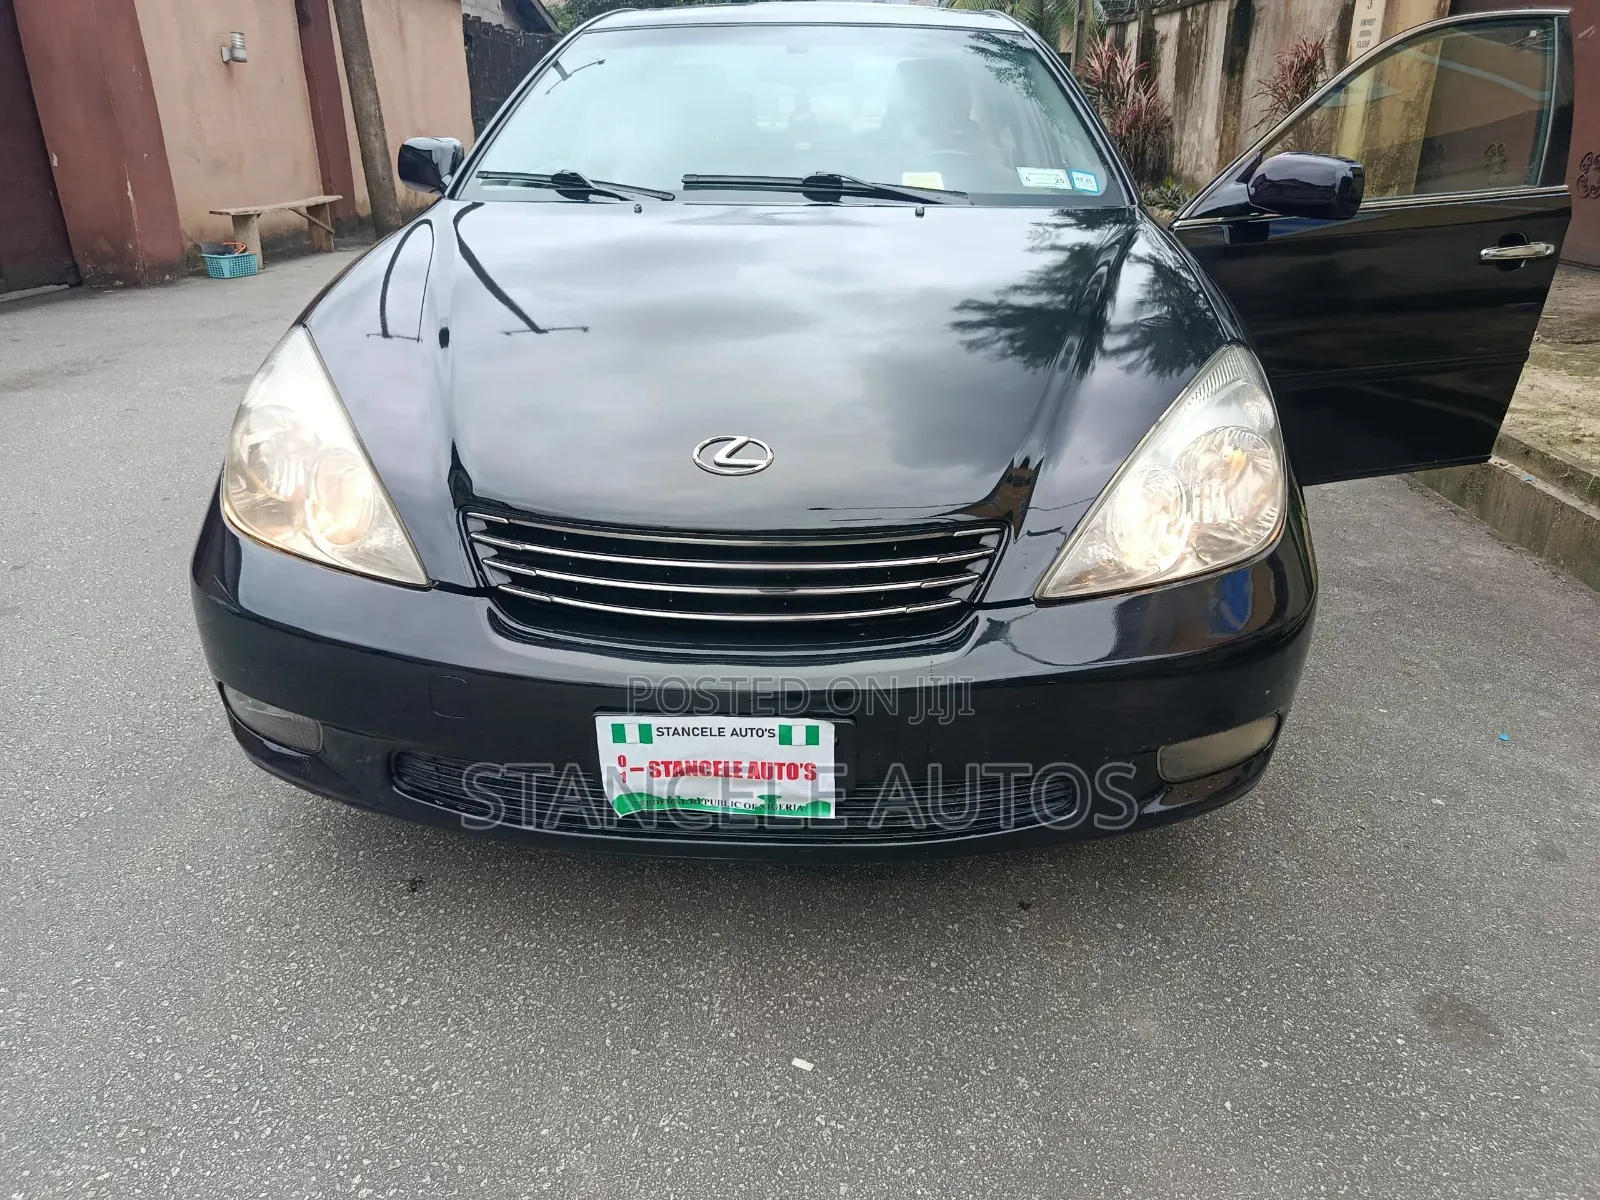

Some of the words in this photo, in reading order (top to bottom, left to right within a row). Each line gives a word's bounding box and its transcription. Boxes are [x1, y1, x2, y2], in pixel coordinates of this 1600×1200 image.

[656, 726, 726, 738] STANCELE
[730, 727, 776, 738] AUTO'S
[648, 759, 743, 778] STANCELE
[747, 761, 817, 781] AUTO'S
[690, 797, 741, 808] REPUBLIC
[743, 803, 757, 811] OF
[759, 803, 804, 813] NIGERIA
